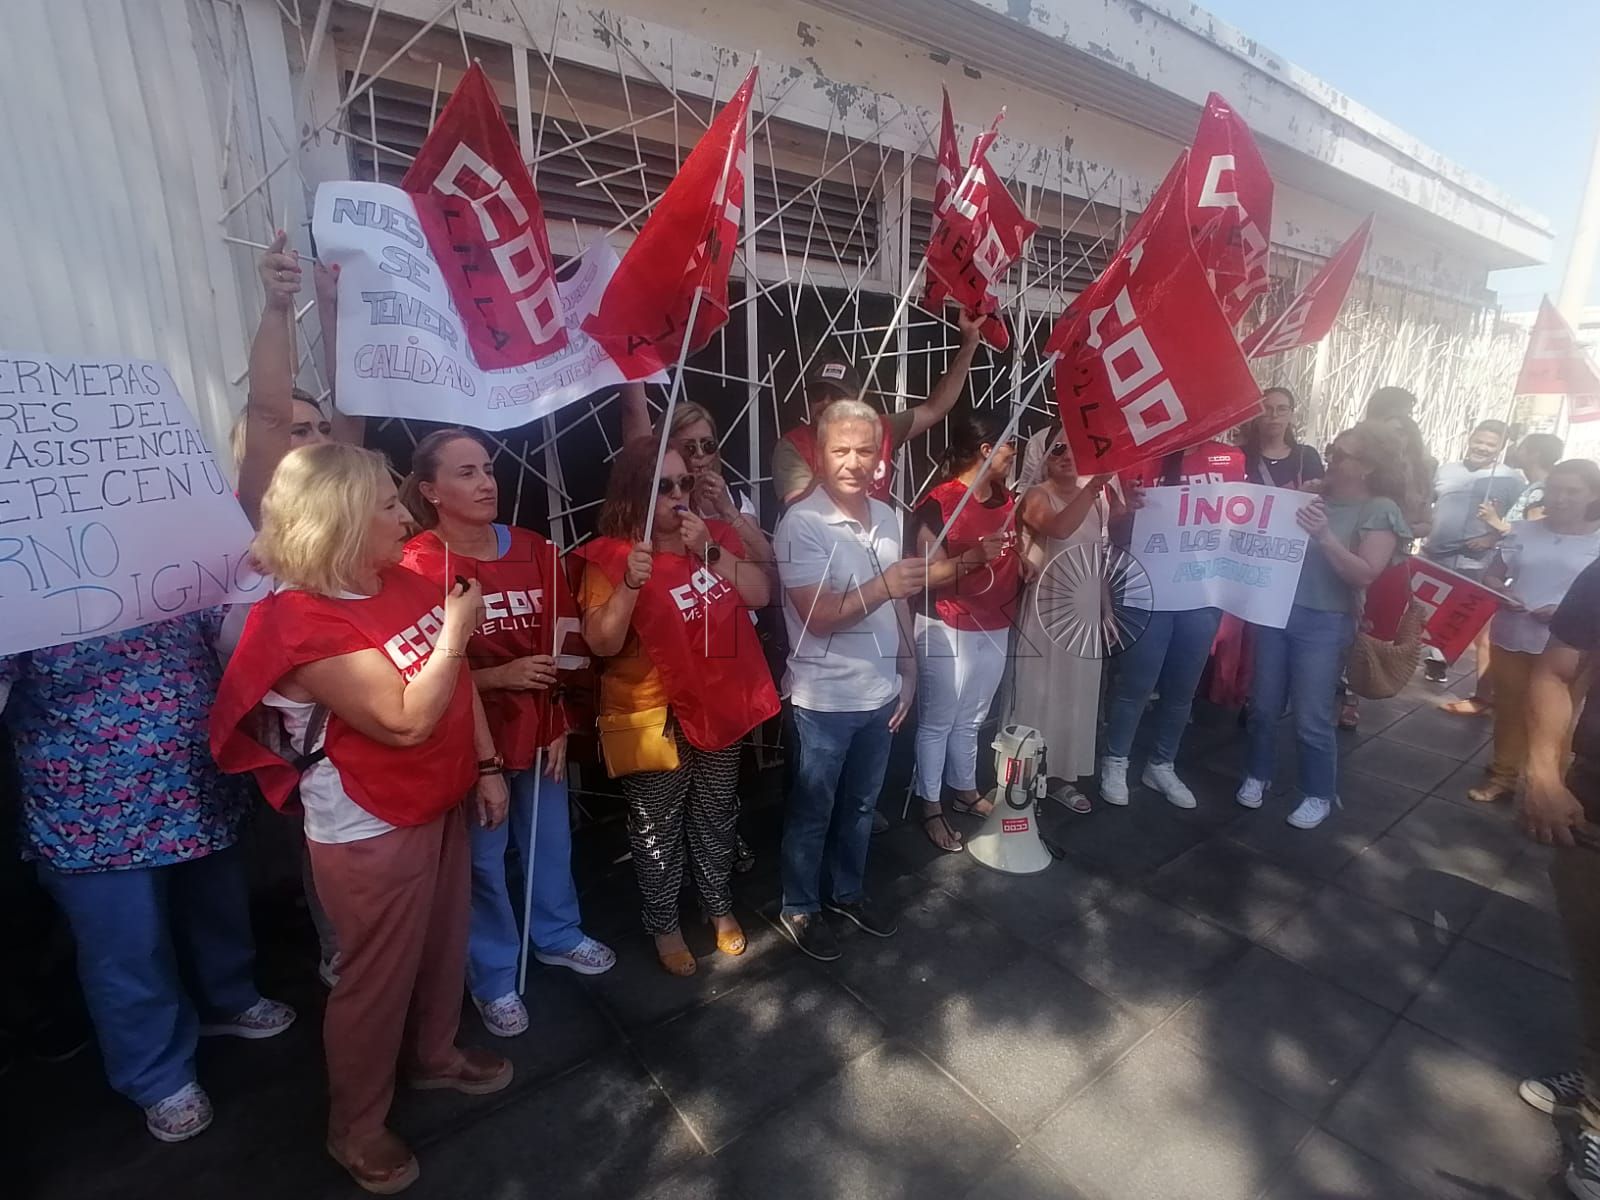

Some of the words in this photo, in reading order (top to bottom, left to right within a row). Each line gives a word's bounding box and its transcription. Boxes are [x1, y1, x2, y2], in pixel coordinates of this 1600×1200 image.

[379, 245, 431, 293] SE
[361, 290, 458, 351] TENER
[109, 402, 182, 430] DEL
[5, 429, 213, 470] ASISTENCIAL
[1178, 487, 1275, 534] ¡NO!
[1143, 533, 1169, 554] A
[1179, 530, 1221, 552] LOS
[1229, 530, 1304, 563] TURNOS
[43, 549, 265, 636] DIGNO
